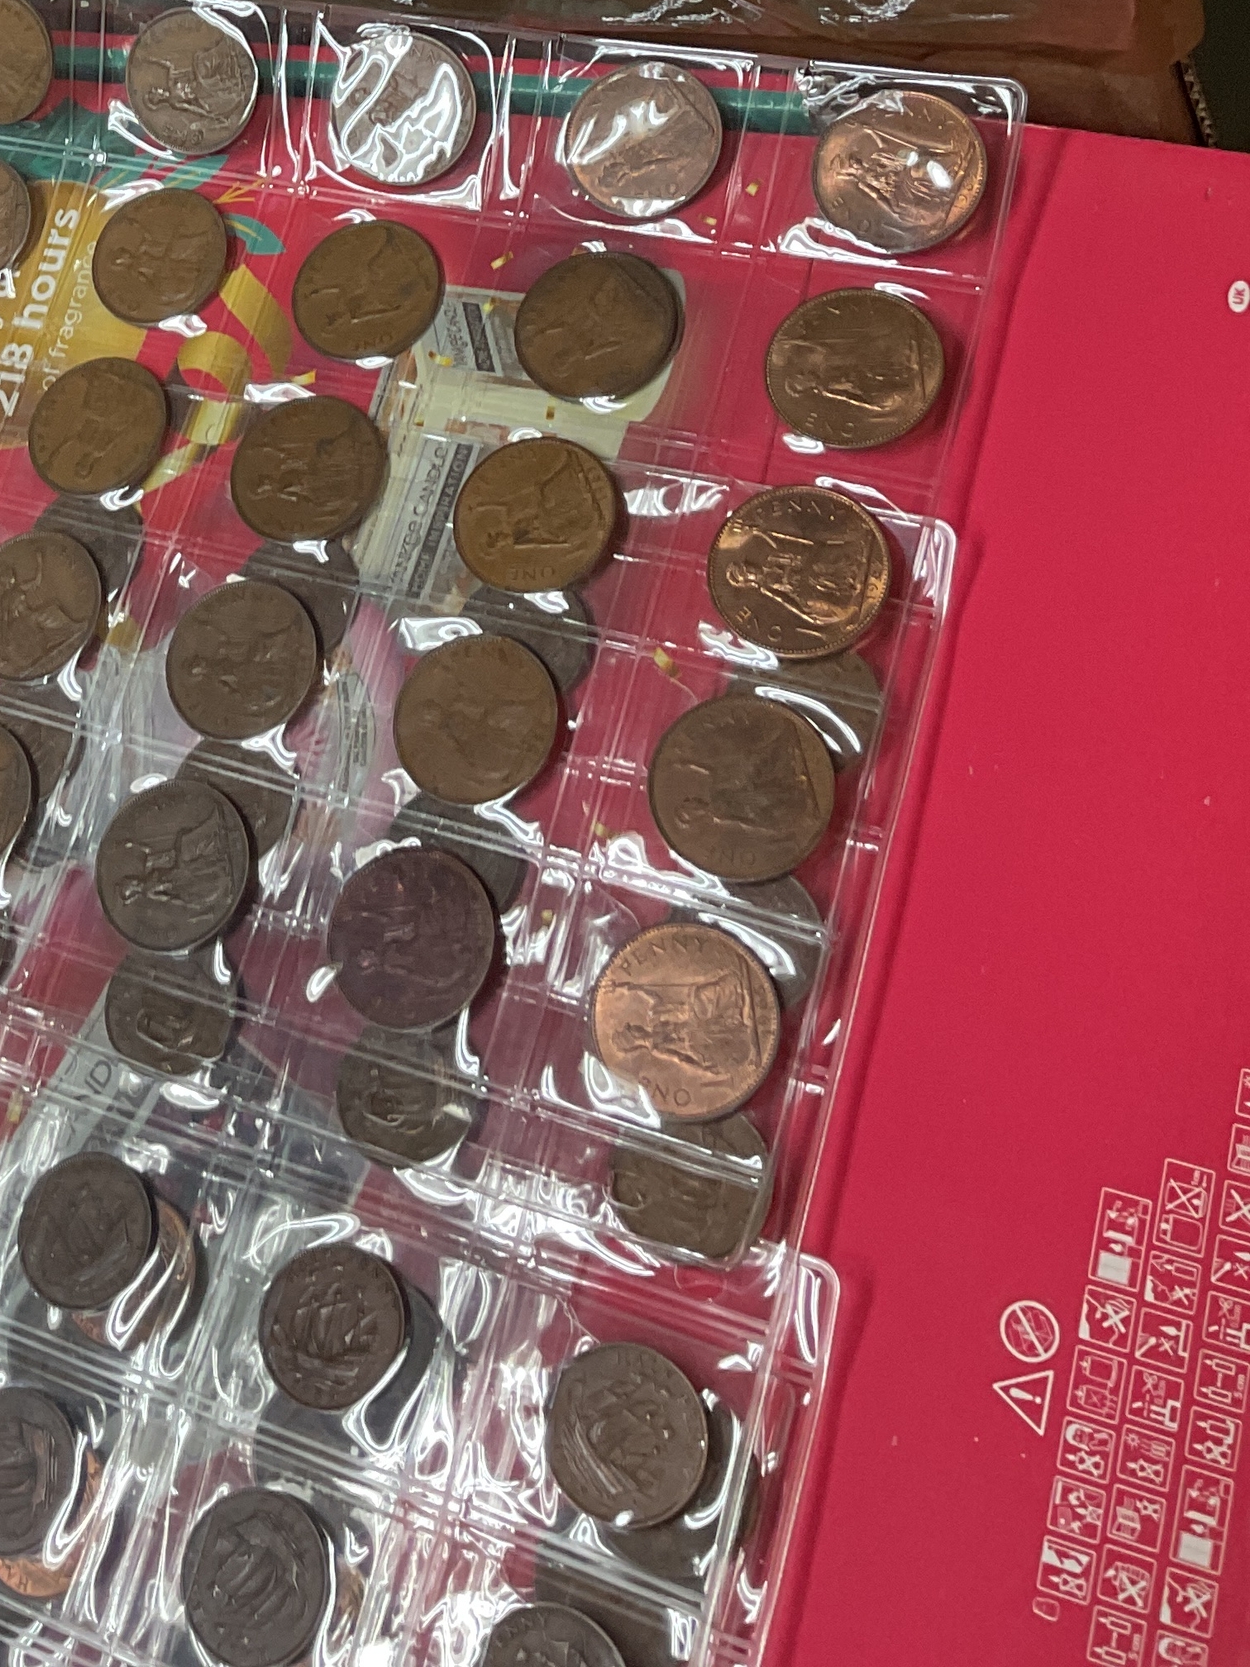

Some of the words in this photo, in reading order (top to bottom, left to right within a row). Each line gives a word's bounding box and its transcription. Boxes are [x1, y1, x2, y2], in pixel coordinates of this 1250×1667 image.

[12, 208, 80, 330] hours
[1232, 287, 1246, 305] UK
[621, 935, 708, 976] PENNY
